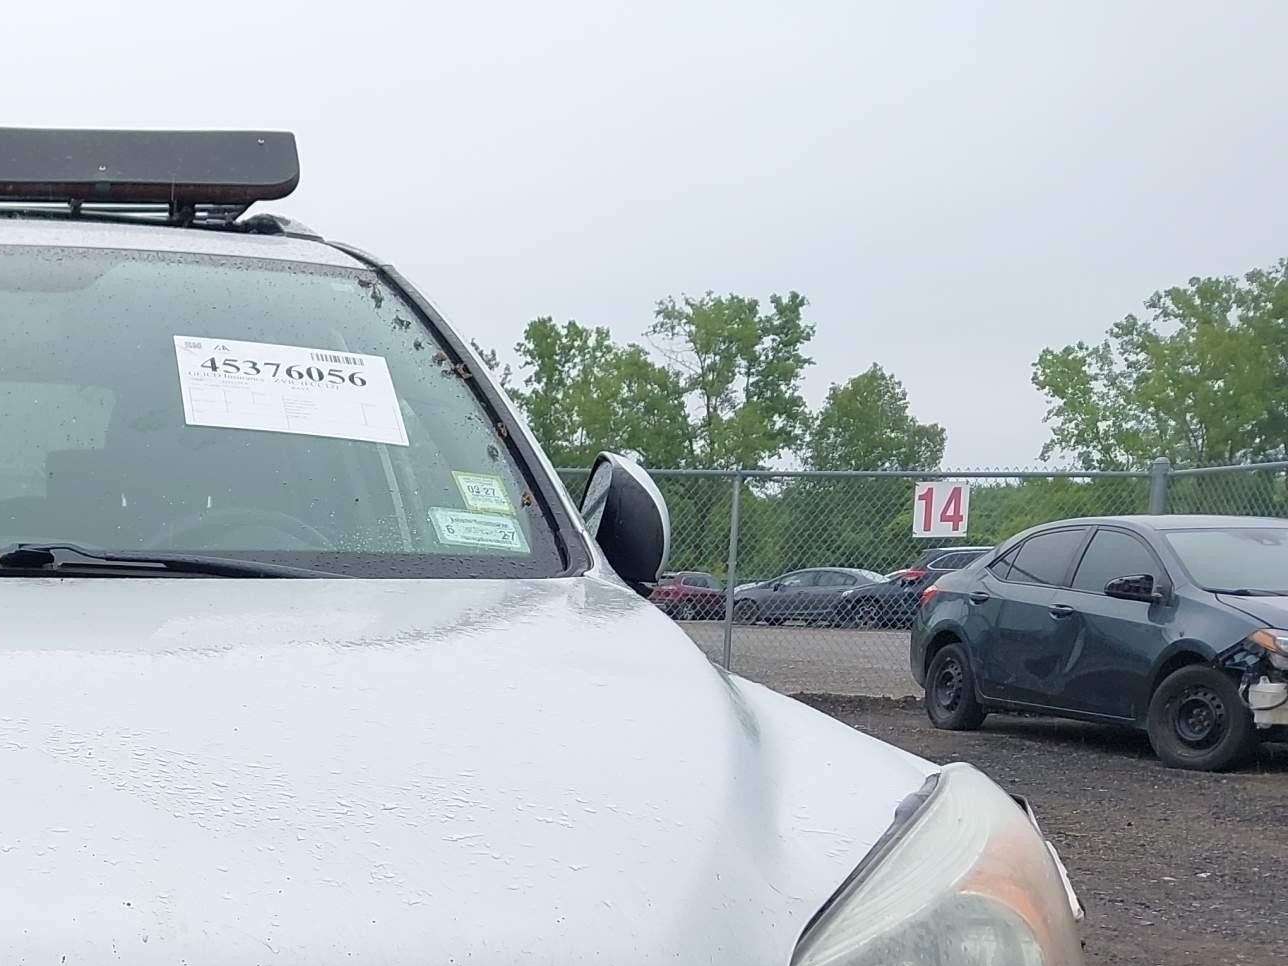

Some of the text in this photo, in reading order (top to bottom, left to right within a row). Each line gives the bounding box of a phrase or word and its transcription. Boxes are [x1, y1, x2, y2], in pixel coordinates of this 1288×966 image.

[200, 356, 367, 387] 45376056
[918, 486, 964, 532] 14
[499, 530, 515, 541] 27
